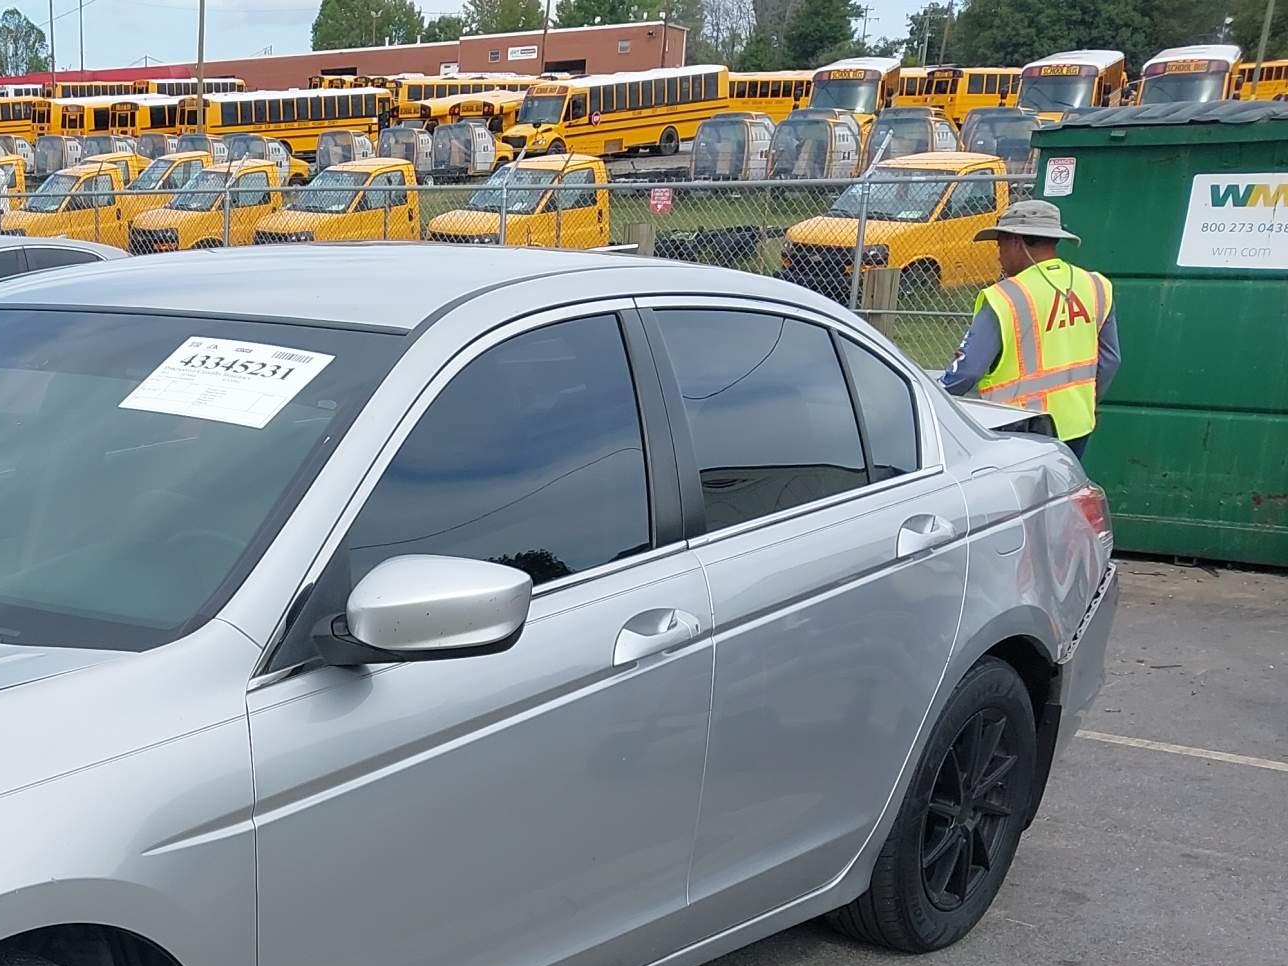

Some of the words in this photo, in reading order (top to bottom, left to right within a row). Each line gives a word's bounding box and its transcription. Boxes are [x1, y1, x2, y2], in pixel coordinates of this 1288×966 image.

[1210, 184, 1288, 208] WM
[1201, 222, 1226, 233] 800
[1229, 222, 1253, 233] 273
[1212, 247, 1272, 257] wm.com
[179, 353, 295, 380] 43345231
